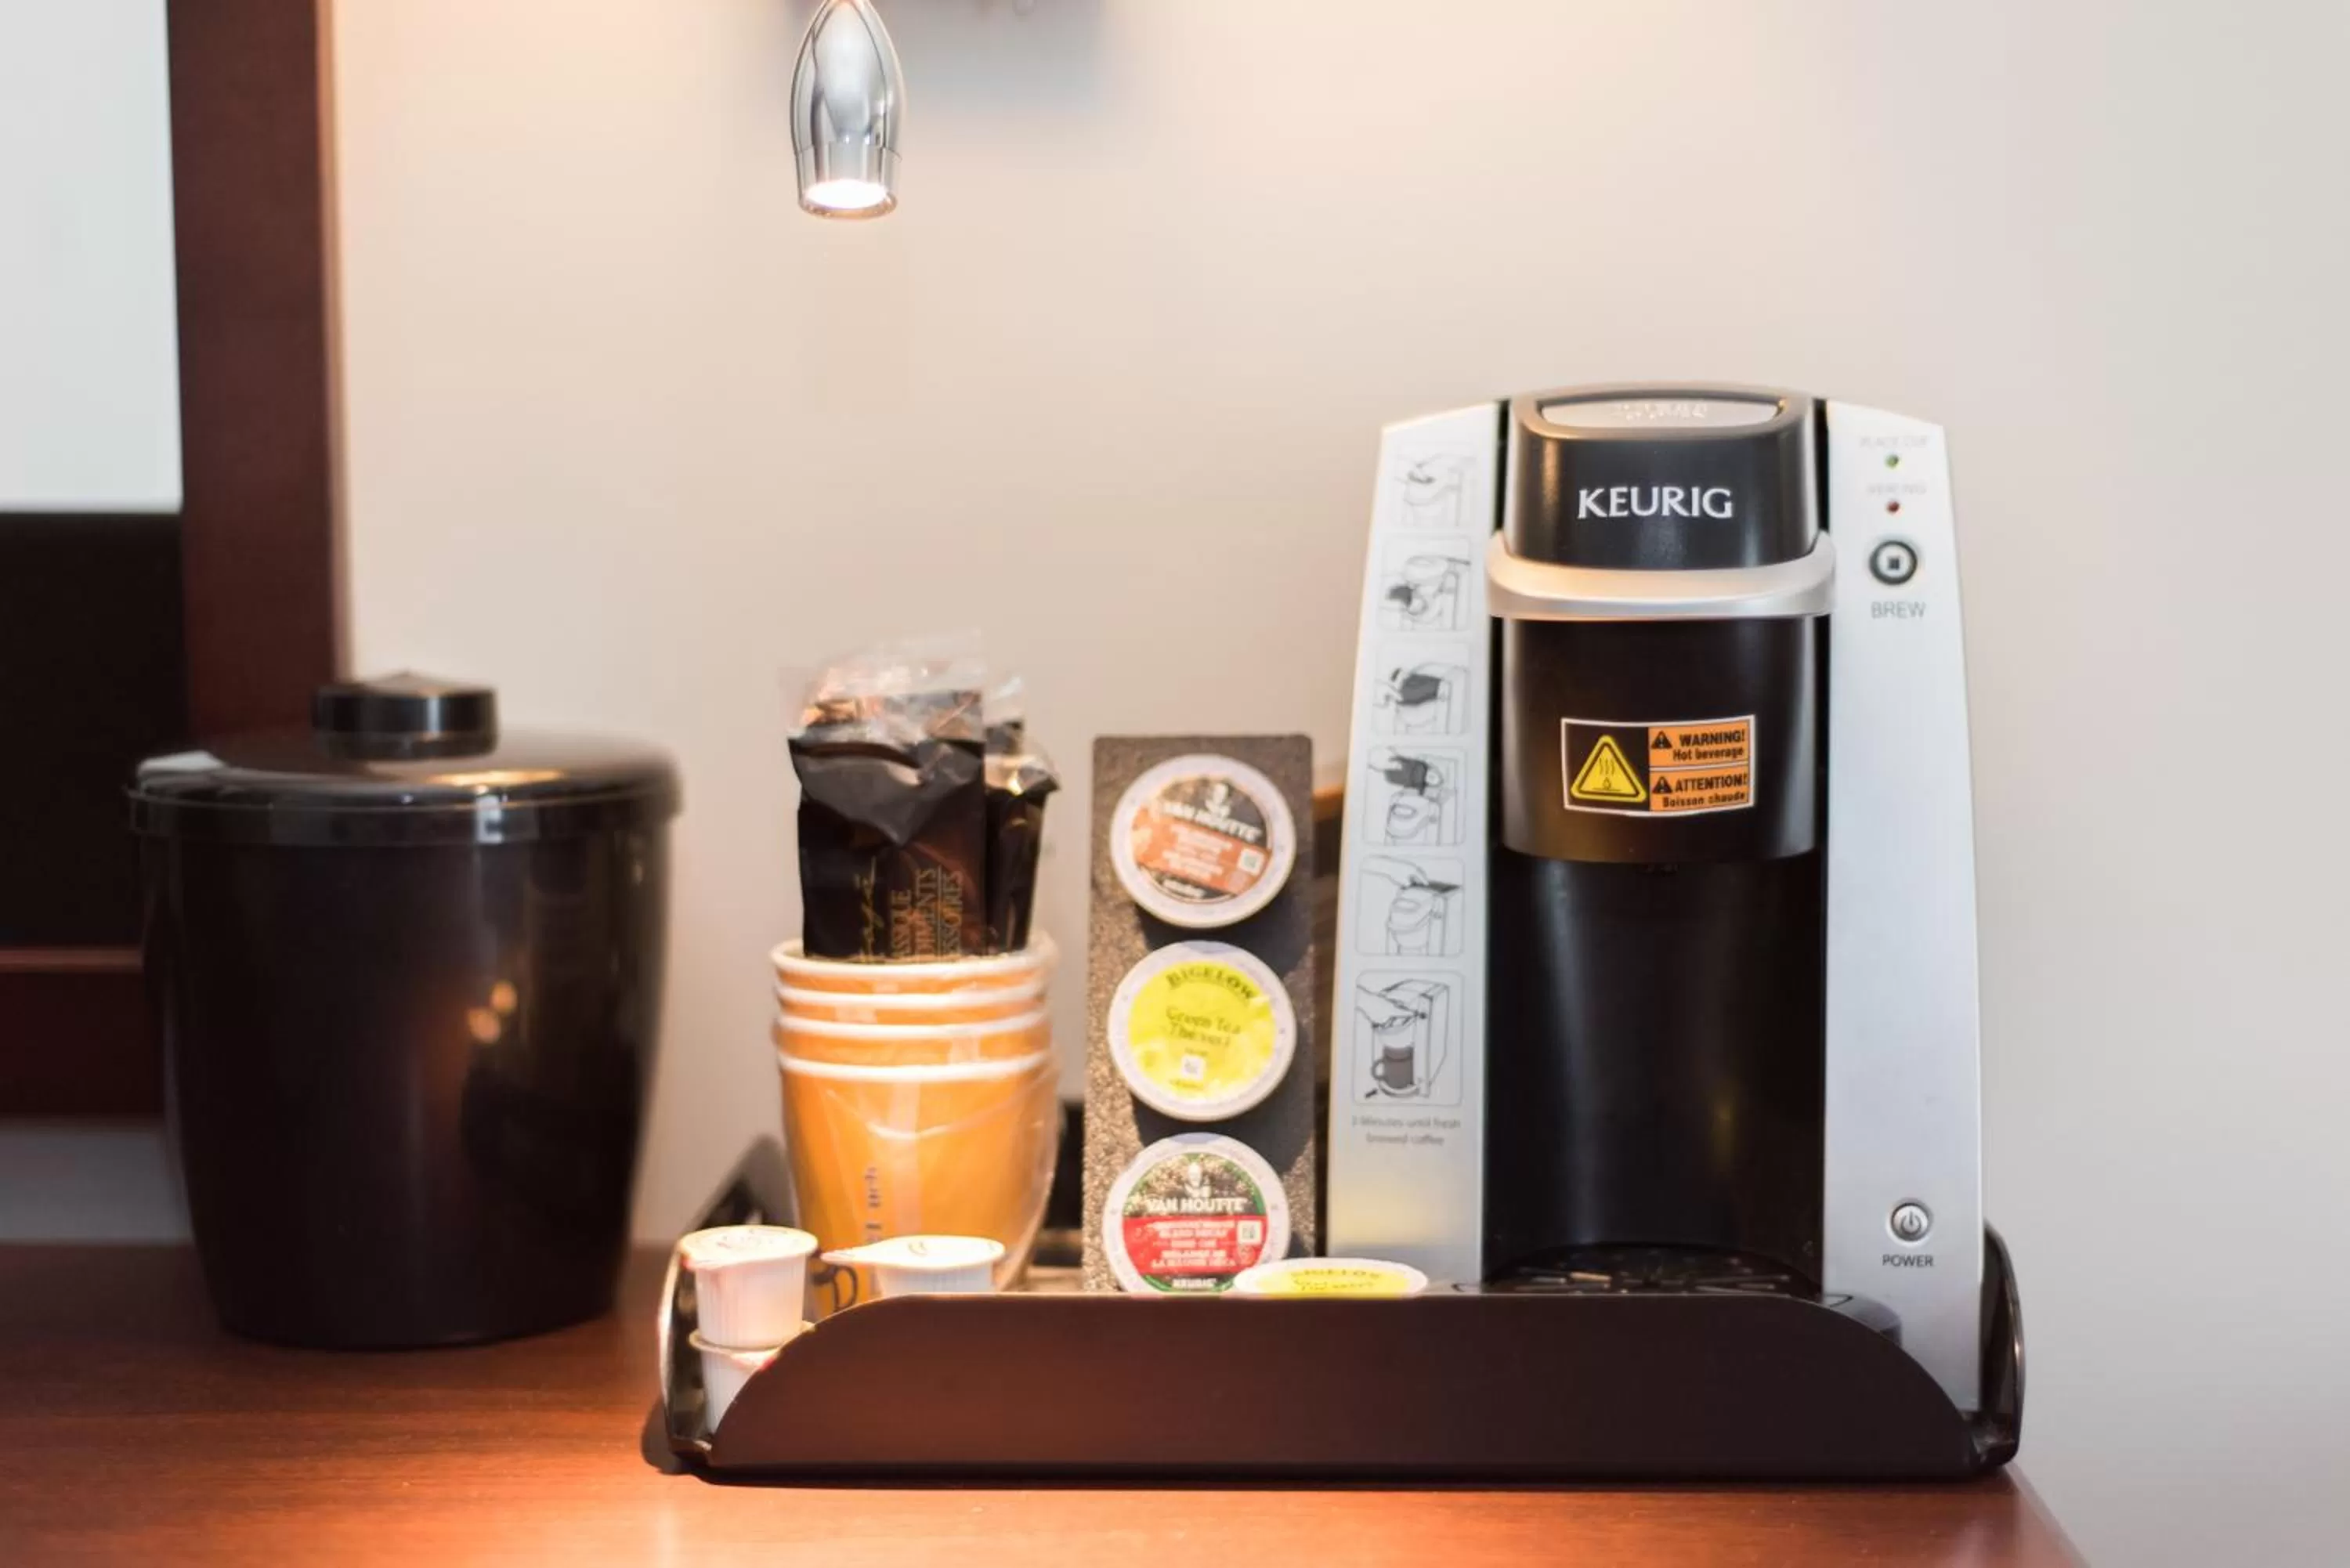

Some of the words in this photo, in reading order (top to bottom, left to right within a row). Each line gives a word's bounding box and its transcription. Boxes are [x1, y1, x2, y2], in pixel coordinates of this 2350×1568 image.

[1578, 486, 1734, 519] KEURIG
[1870, 602, 1926, 619] BREW
[1679, 729, 1745, 747] WARNING!
[1672, 749, 1693, 761] Hot
[1695, 746, 1744, 761] beverage
[1675, 773, 1748, 793] ATTENTION!
[1662, 796, 1705, 808] Boisson
[1708, 791, 1746, 804] chaude
[1166, 966, 1259, 999] BIGELOW
[1146, 1198, 1178, 1213] VAN
[1180, 1197, 1246, 1213] HOUTTE
[1882, 1254, 1934, 1267] POWER
